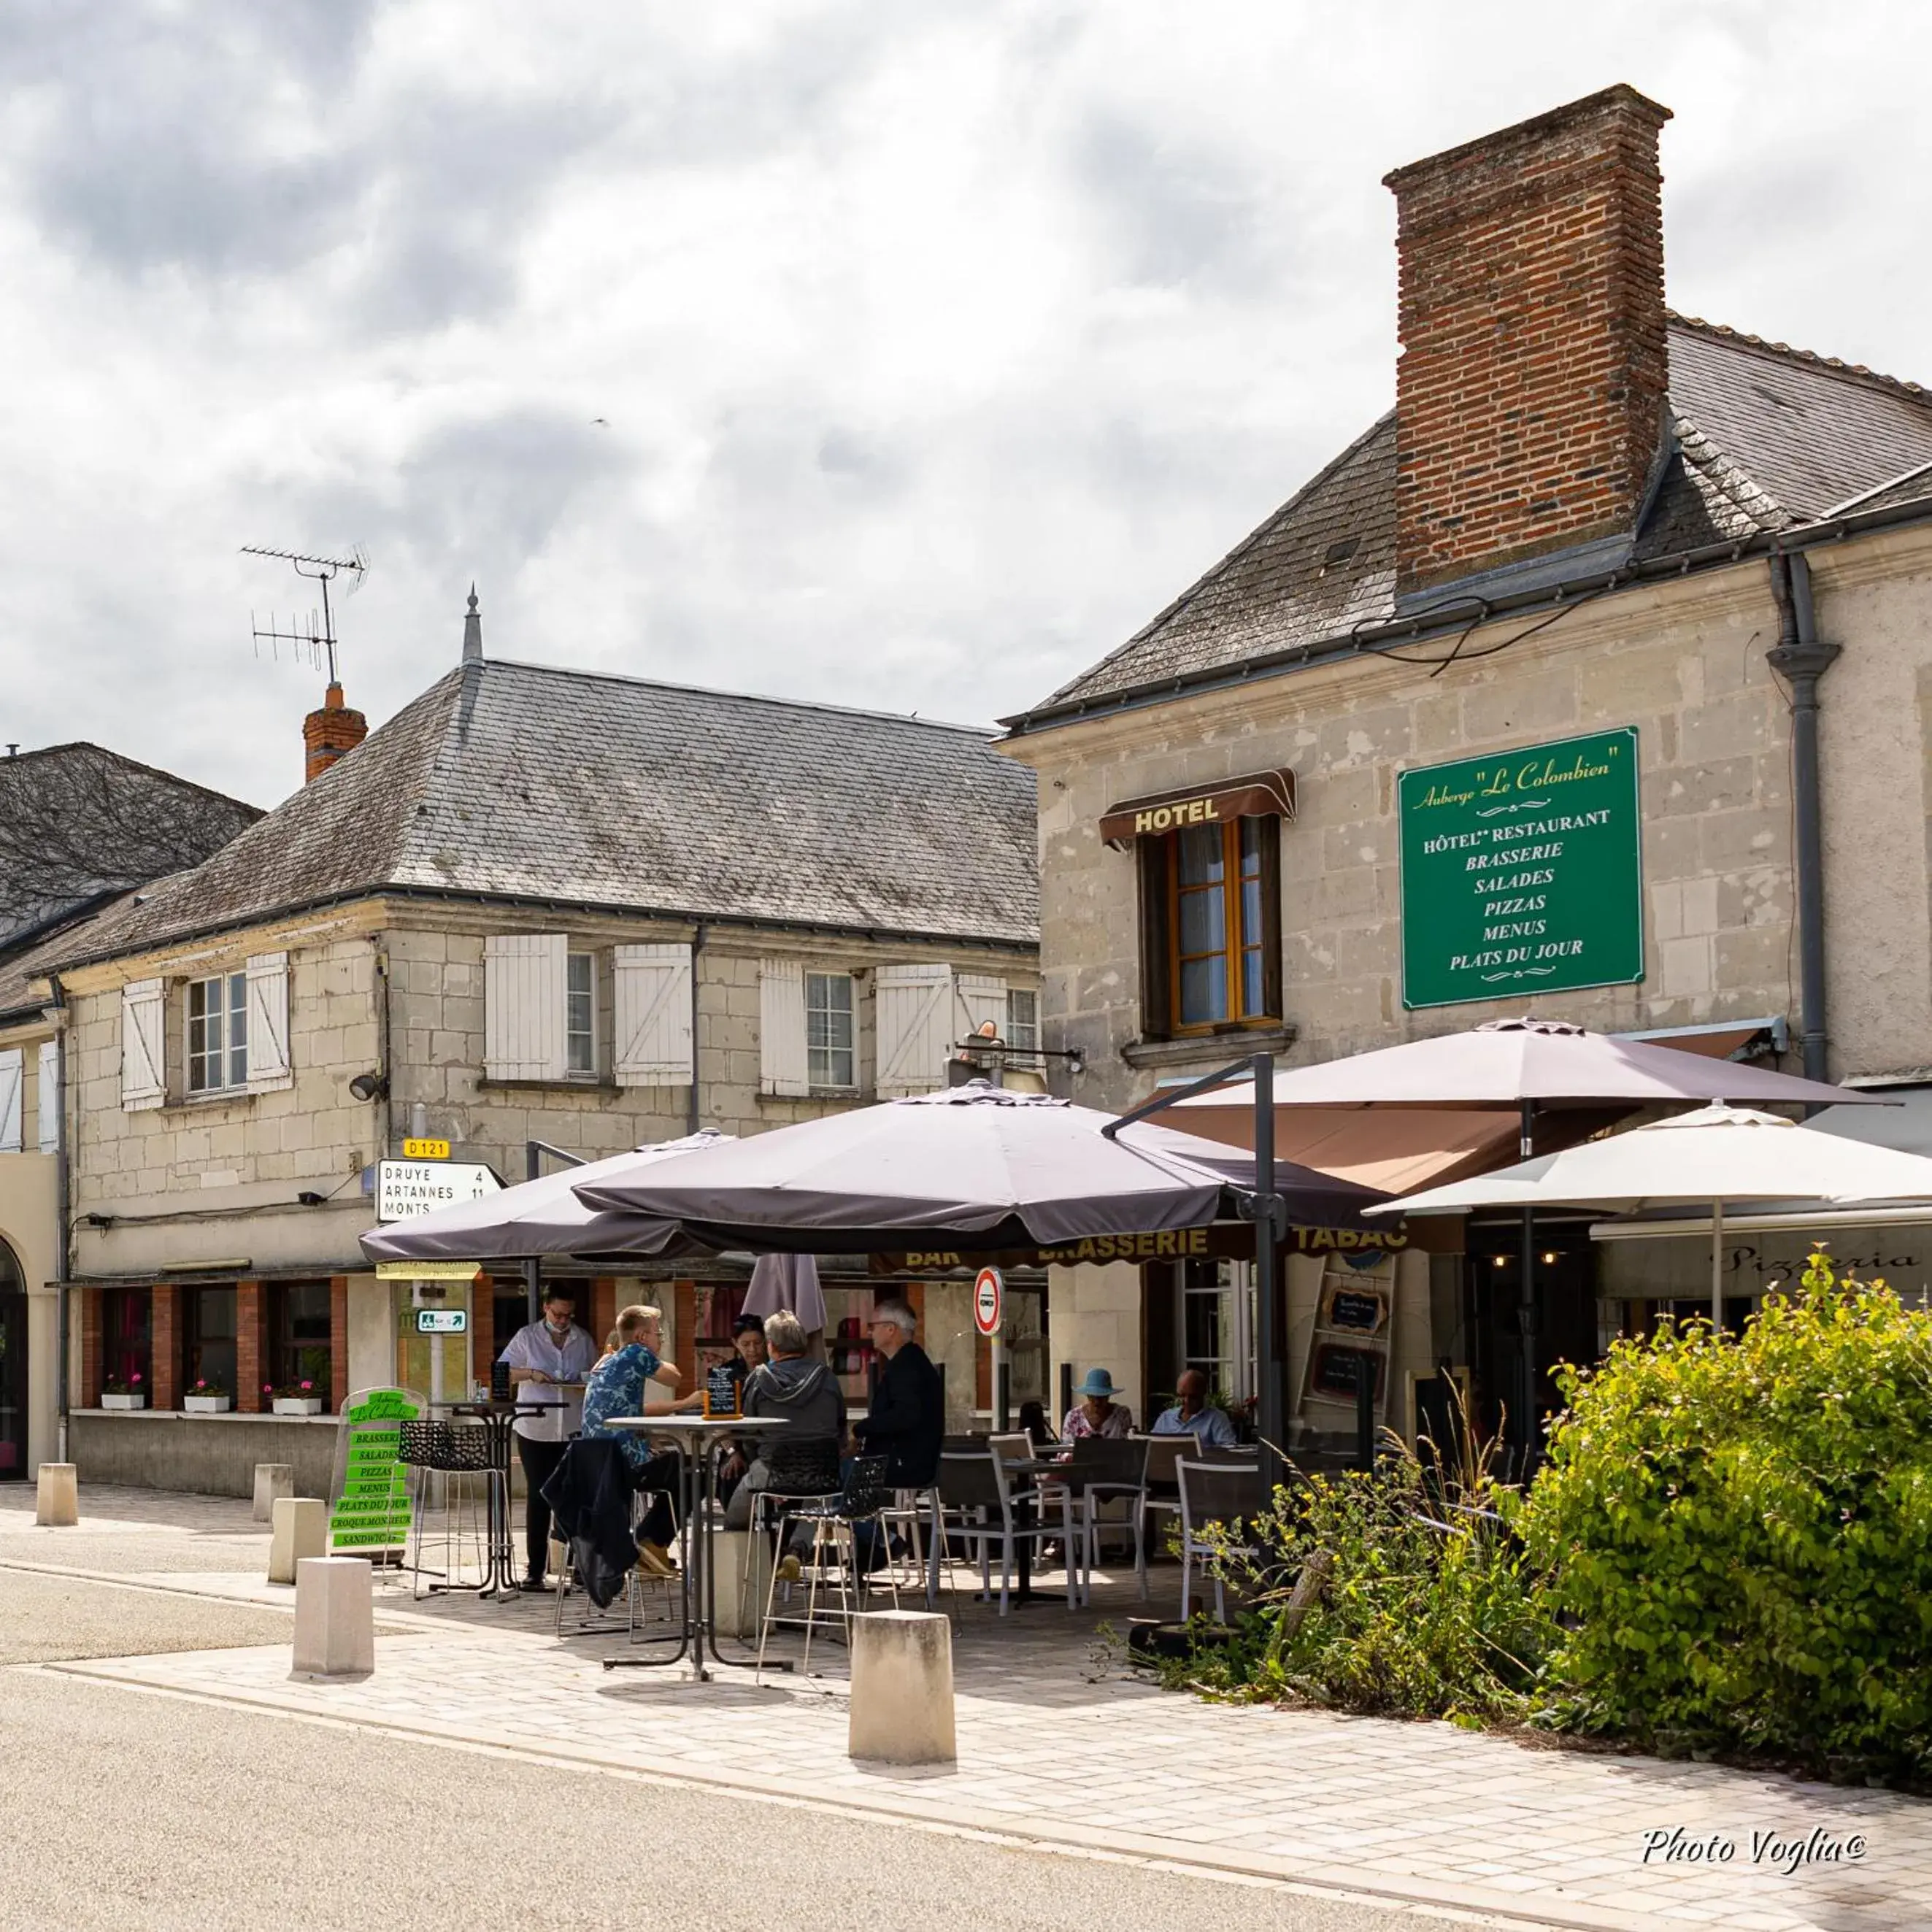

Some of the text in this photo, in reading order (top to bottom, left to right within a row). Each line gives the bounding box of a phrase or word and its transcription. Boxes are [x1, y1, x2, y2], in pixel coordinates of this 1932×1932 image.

[1412, 785, 1474, 810] Auberge
[1135, 798, 1219, 833] HOTEL
[1493, 809, 1611, 842] RESTAURANT
[1465, 842, 1563, 871] BRASSERIE
[1474, 868, 1555, 894] SALADES
[1484, 894, 1547, 917] PIZZAS
[1483, 919, 1547, 942] MENUS
[1450, 939, 1583, 971] PLATS DU JOUR
[385, 1168, 483, 1182] DRUYE 4
[385, 1185, 483, 1199] ARTANNES 11
[385, 1203, 430, 1215] MONTS
[1291, 1221, 1409, 1250] TABAC
[356, 1433, 399, 1444] BRASSERI
[361, 1466, 393, 1476] PIZZAS
[358, 1482, 391, 1493] MENUS
[339, 1501, 368, 1512] PLATS
[369, 1500, 382, 1510] DU
[331, 1518, 366, 1528] CROQUE
